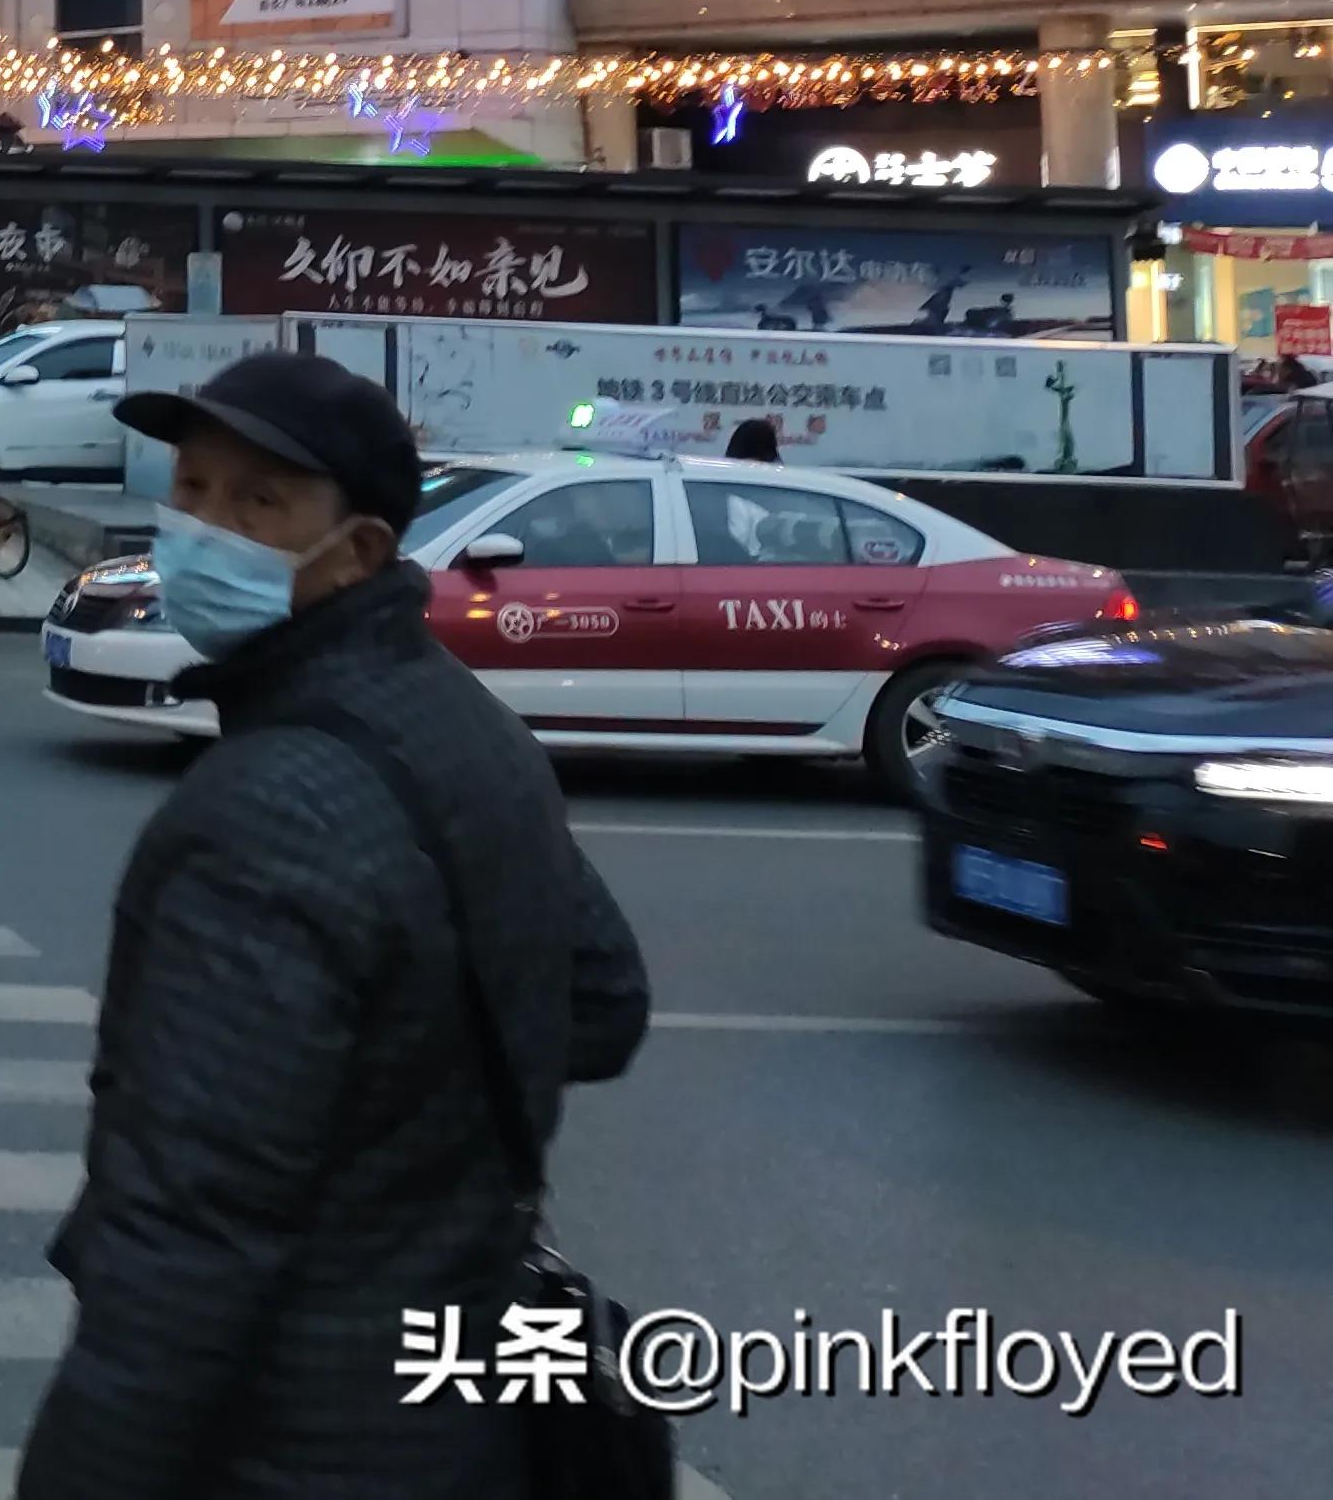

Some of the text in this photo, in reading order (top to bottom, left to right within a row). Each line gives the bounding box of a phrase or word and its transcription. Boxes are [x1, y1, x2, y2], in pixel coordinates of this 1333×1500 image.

[277, 233, 589, 300] 久仰不如亲见
[718, 598, 806, 630] TAXI
